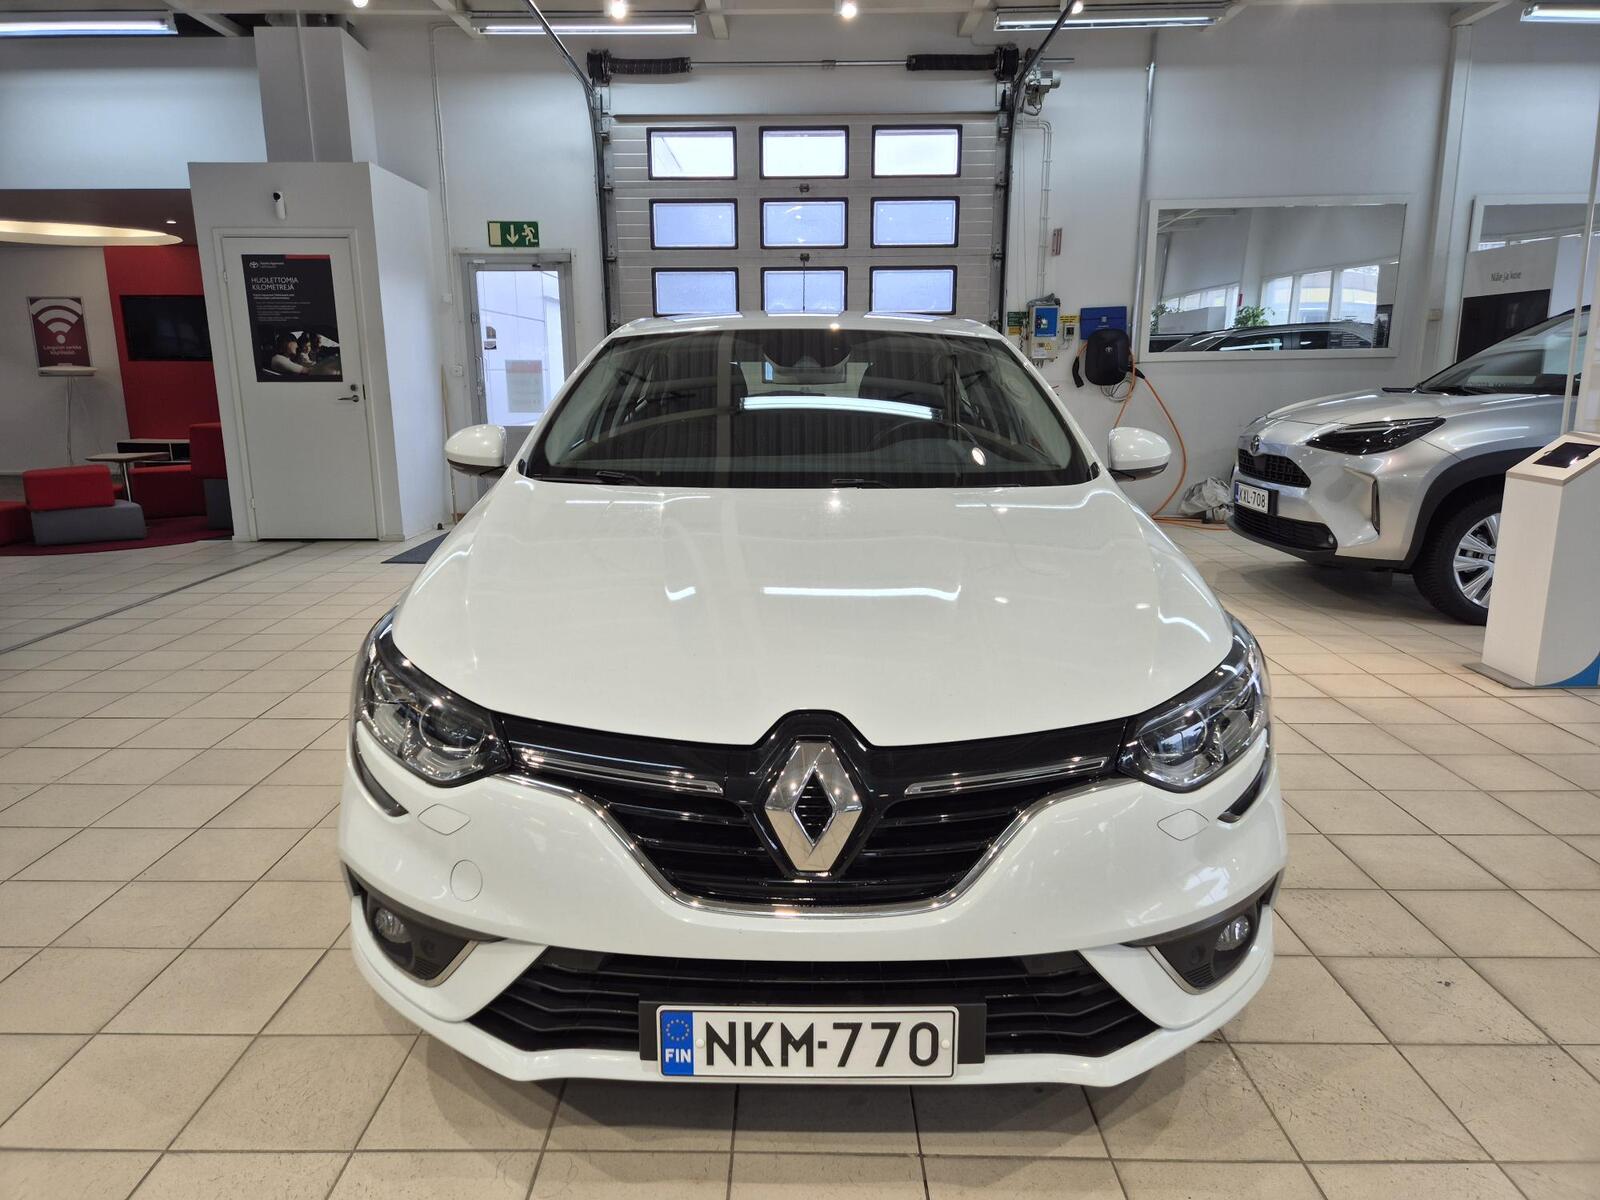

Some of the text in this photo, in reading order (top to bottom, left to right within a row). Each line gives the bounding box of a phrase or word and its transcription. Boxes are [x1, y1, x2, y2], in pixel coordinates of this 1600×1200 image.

[251, 276, 299, 284] HUOLETTOMIA
[665, 1021, 940, 1068] FIN NKM-770
